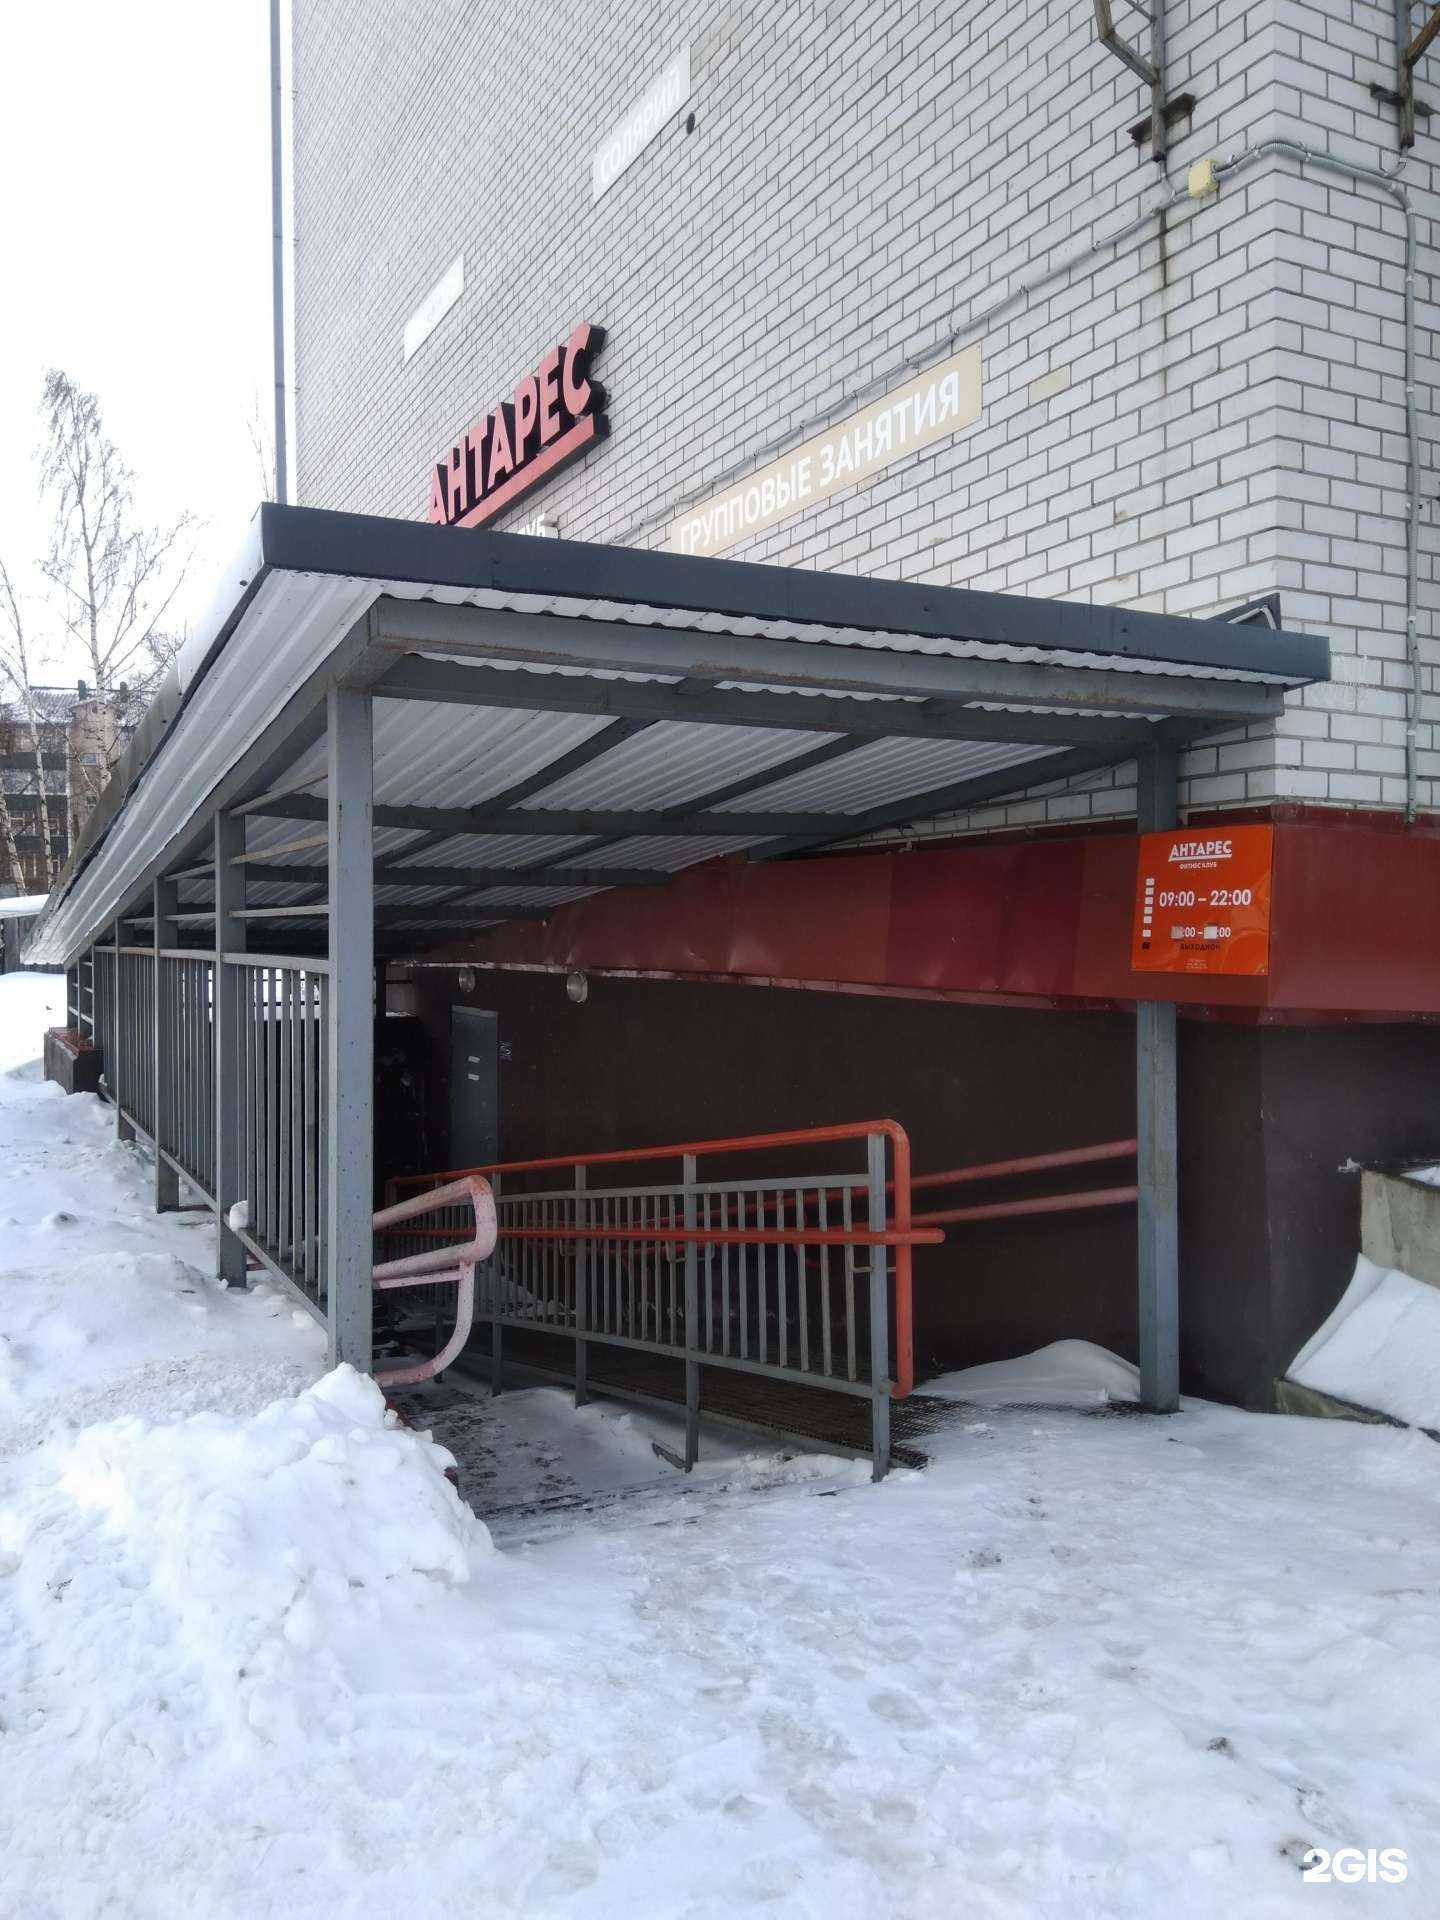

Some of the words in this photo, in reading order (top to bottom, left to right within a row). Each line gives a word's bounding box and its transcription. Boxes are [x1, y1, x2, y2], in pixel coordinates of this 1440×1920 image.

[600, 63, 681, 183] СОЛЯРИЙ
[427, 320, 592, 525] АНТАРЕС
[680, 456, 813, 554] ГРУППОВЫЕ
[819, 370, 960, 487] ЗАНЯТИЯ
[1159, 891, 1195, 907] 09:00
[1210, 889, 1252, 906] 22:00
[1169, 840, 1232, 859] АНТАРЕС
